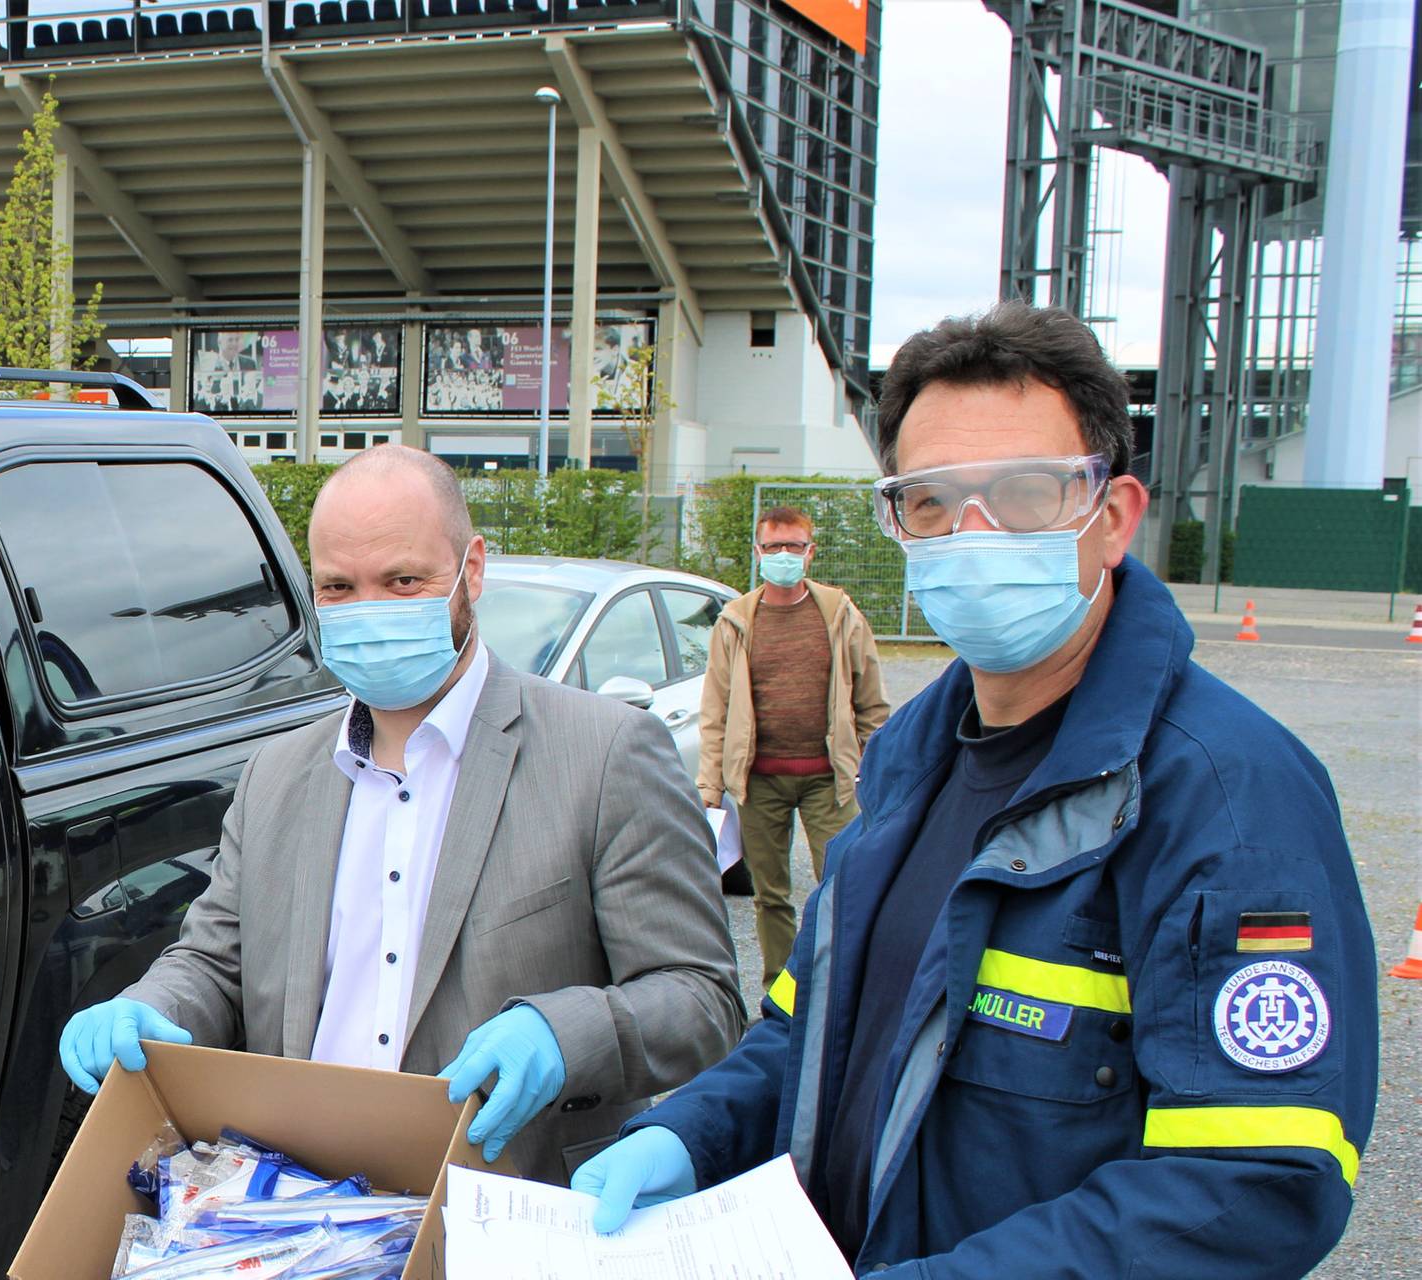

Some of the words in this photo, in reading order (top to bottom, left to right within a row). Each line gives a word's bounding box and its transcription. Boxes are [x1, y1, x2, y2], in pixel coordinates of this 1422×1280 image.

[1223, 963, 1319, 994] BUNDESANSTALT
[1217, 1025, 1280, 1069] TECHNISCHES
[1283, 1022, 1328, 1067] HILFSWERK
[236, 1256, 262, 1271] 3M
